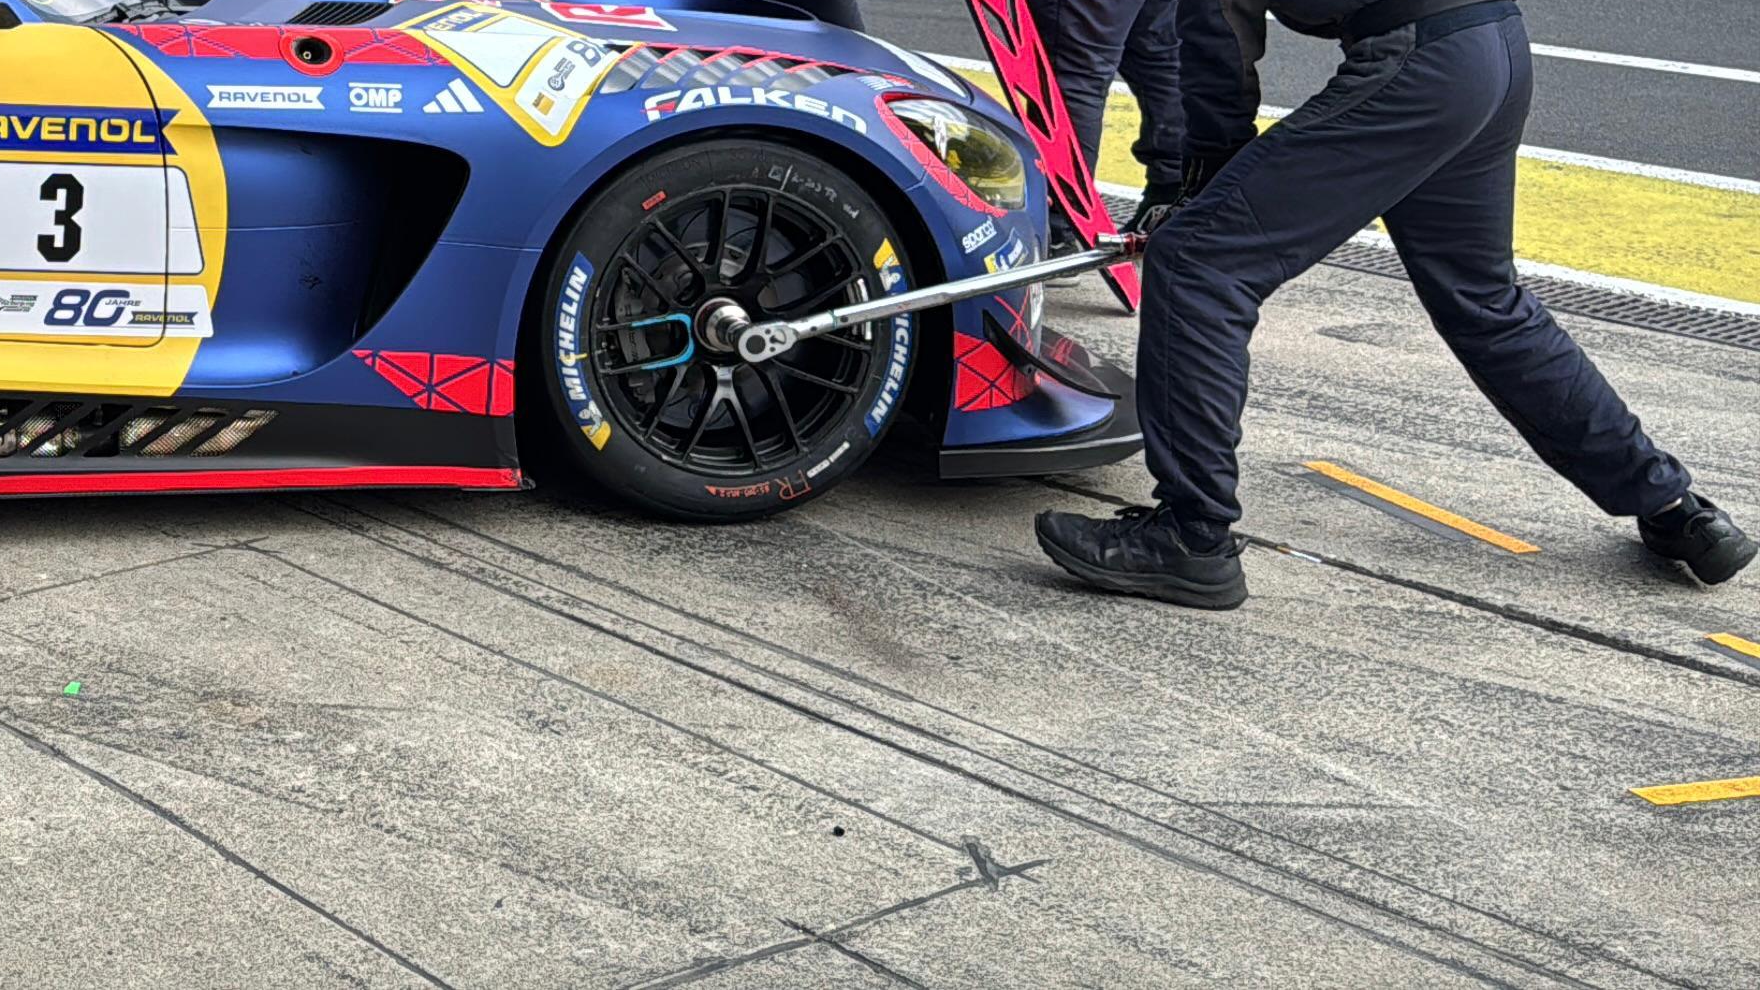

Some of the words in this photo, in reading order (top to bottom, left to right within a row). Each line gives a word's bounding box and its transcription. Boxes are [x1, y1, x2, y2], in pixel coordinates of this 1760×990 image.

[218, 91, 314, 104] RAVENOL
[349, 87, 402, 107] OMP
[644, 86, 868, 135] FALKEN
[37, 173, 84, 262] 3
[43, 288, 131, 327] 80
[104, 298, 143, 307] JAHRE
[134, 314, 191, 323] RAVENOL
[558, 265, 588, 401] MICHELIN
[871, 312, 911, 424] ICHELIN
